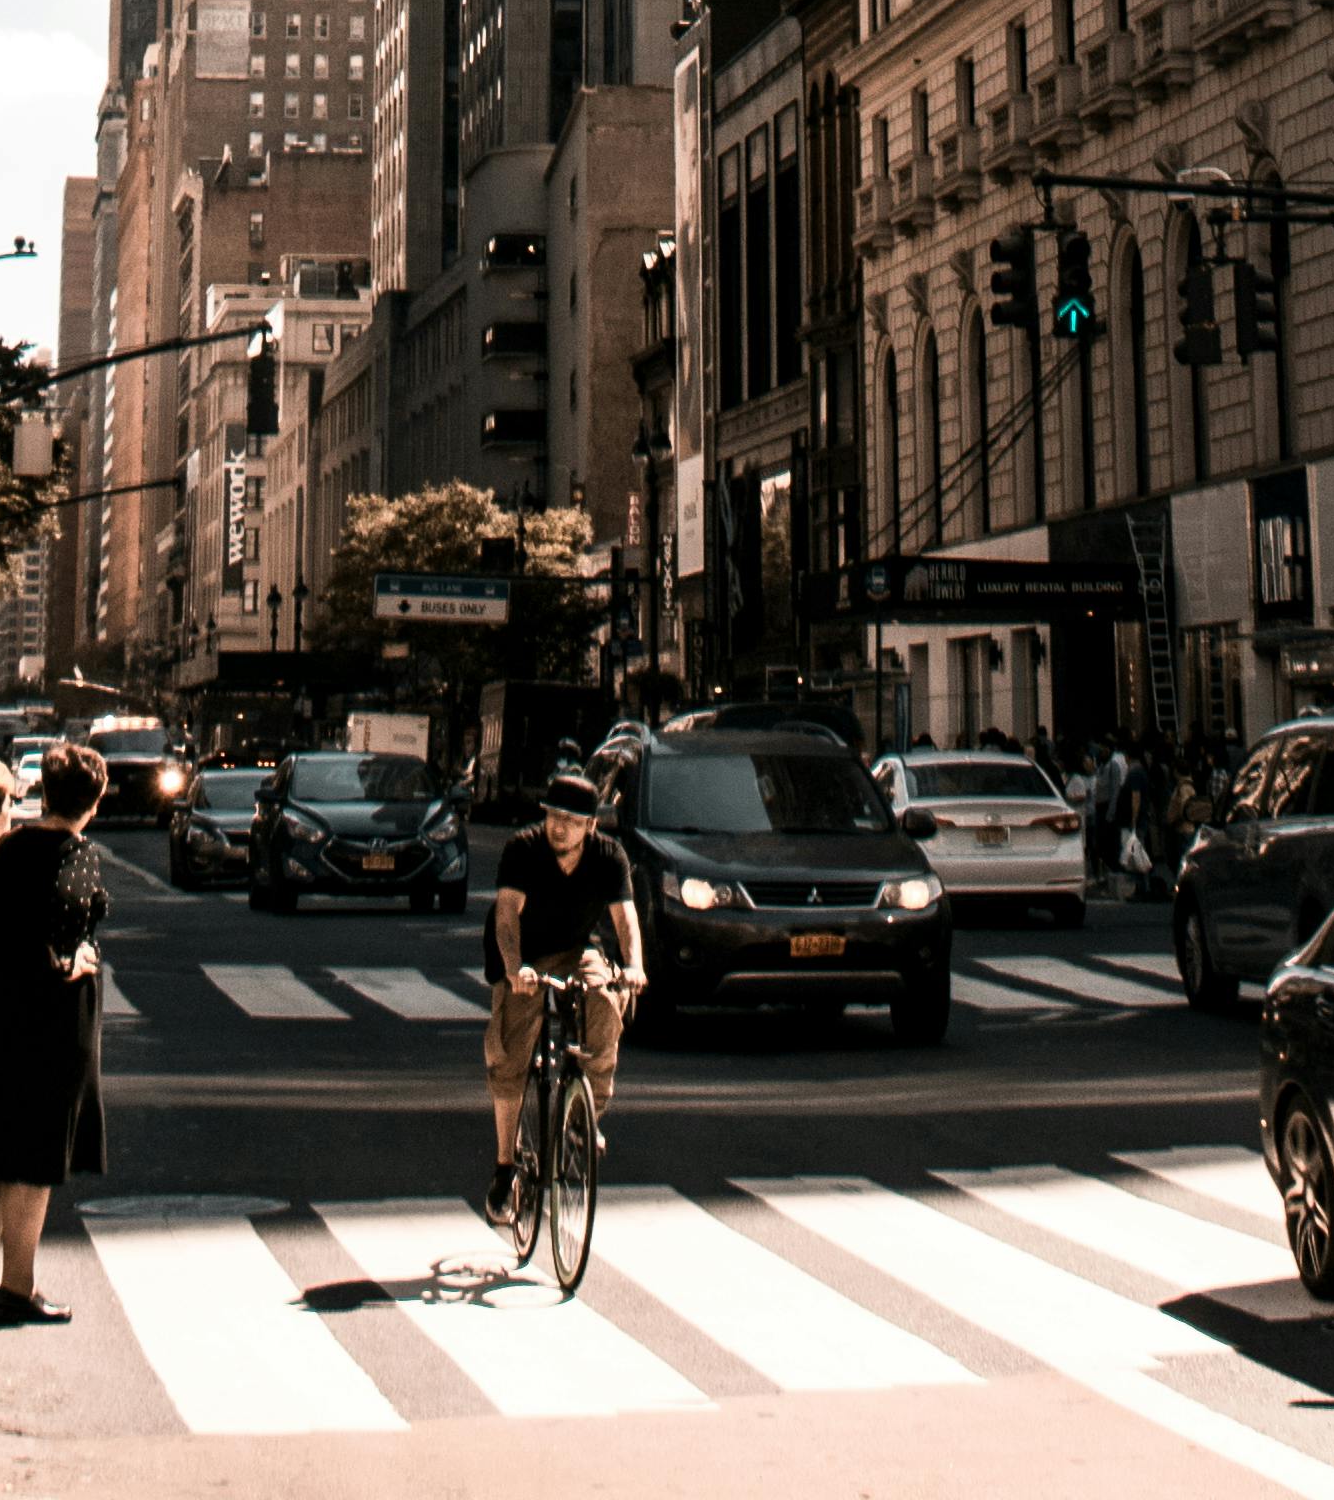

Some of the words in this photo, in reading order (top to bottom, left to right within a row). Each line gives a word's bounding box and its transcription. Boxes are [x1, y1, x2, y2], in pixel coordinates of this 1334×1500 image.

[224, 448, 246, 566] wework
[977, 581, 1020, 595] LUXURY
[1025, 581, 1067, 594] RENTAL
[1071, 580, 1124, 593] BUILDING
[421, 601, 456, 614] BUSES
[460, 602, 487, 615] ONLY
